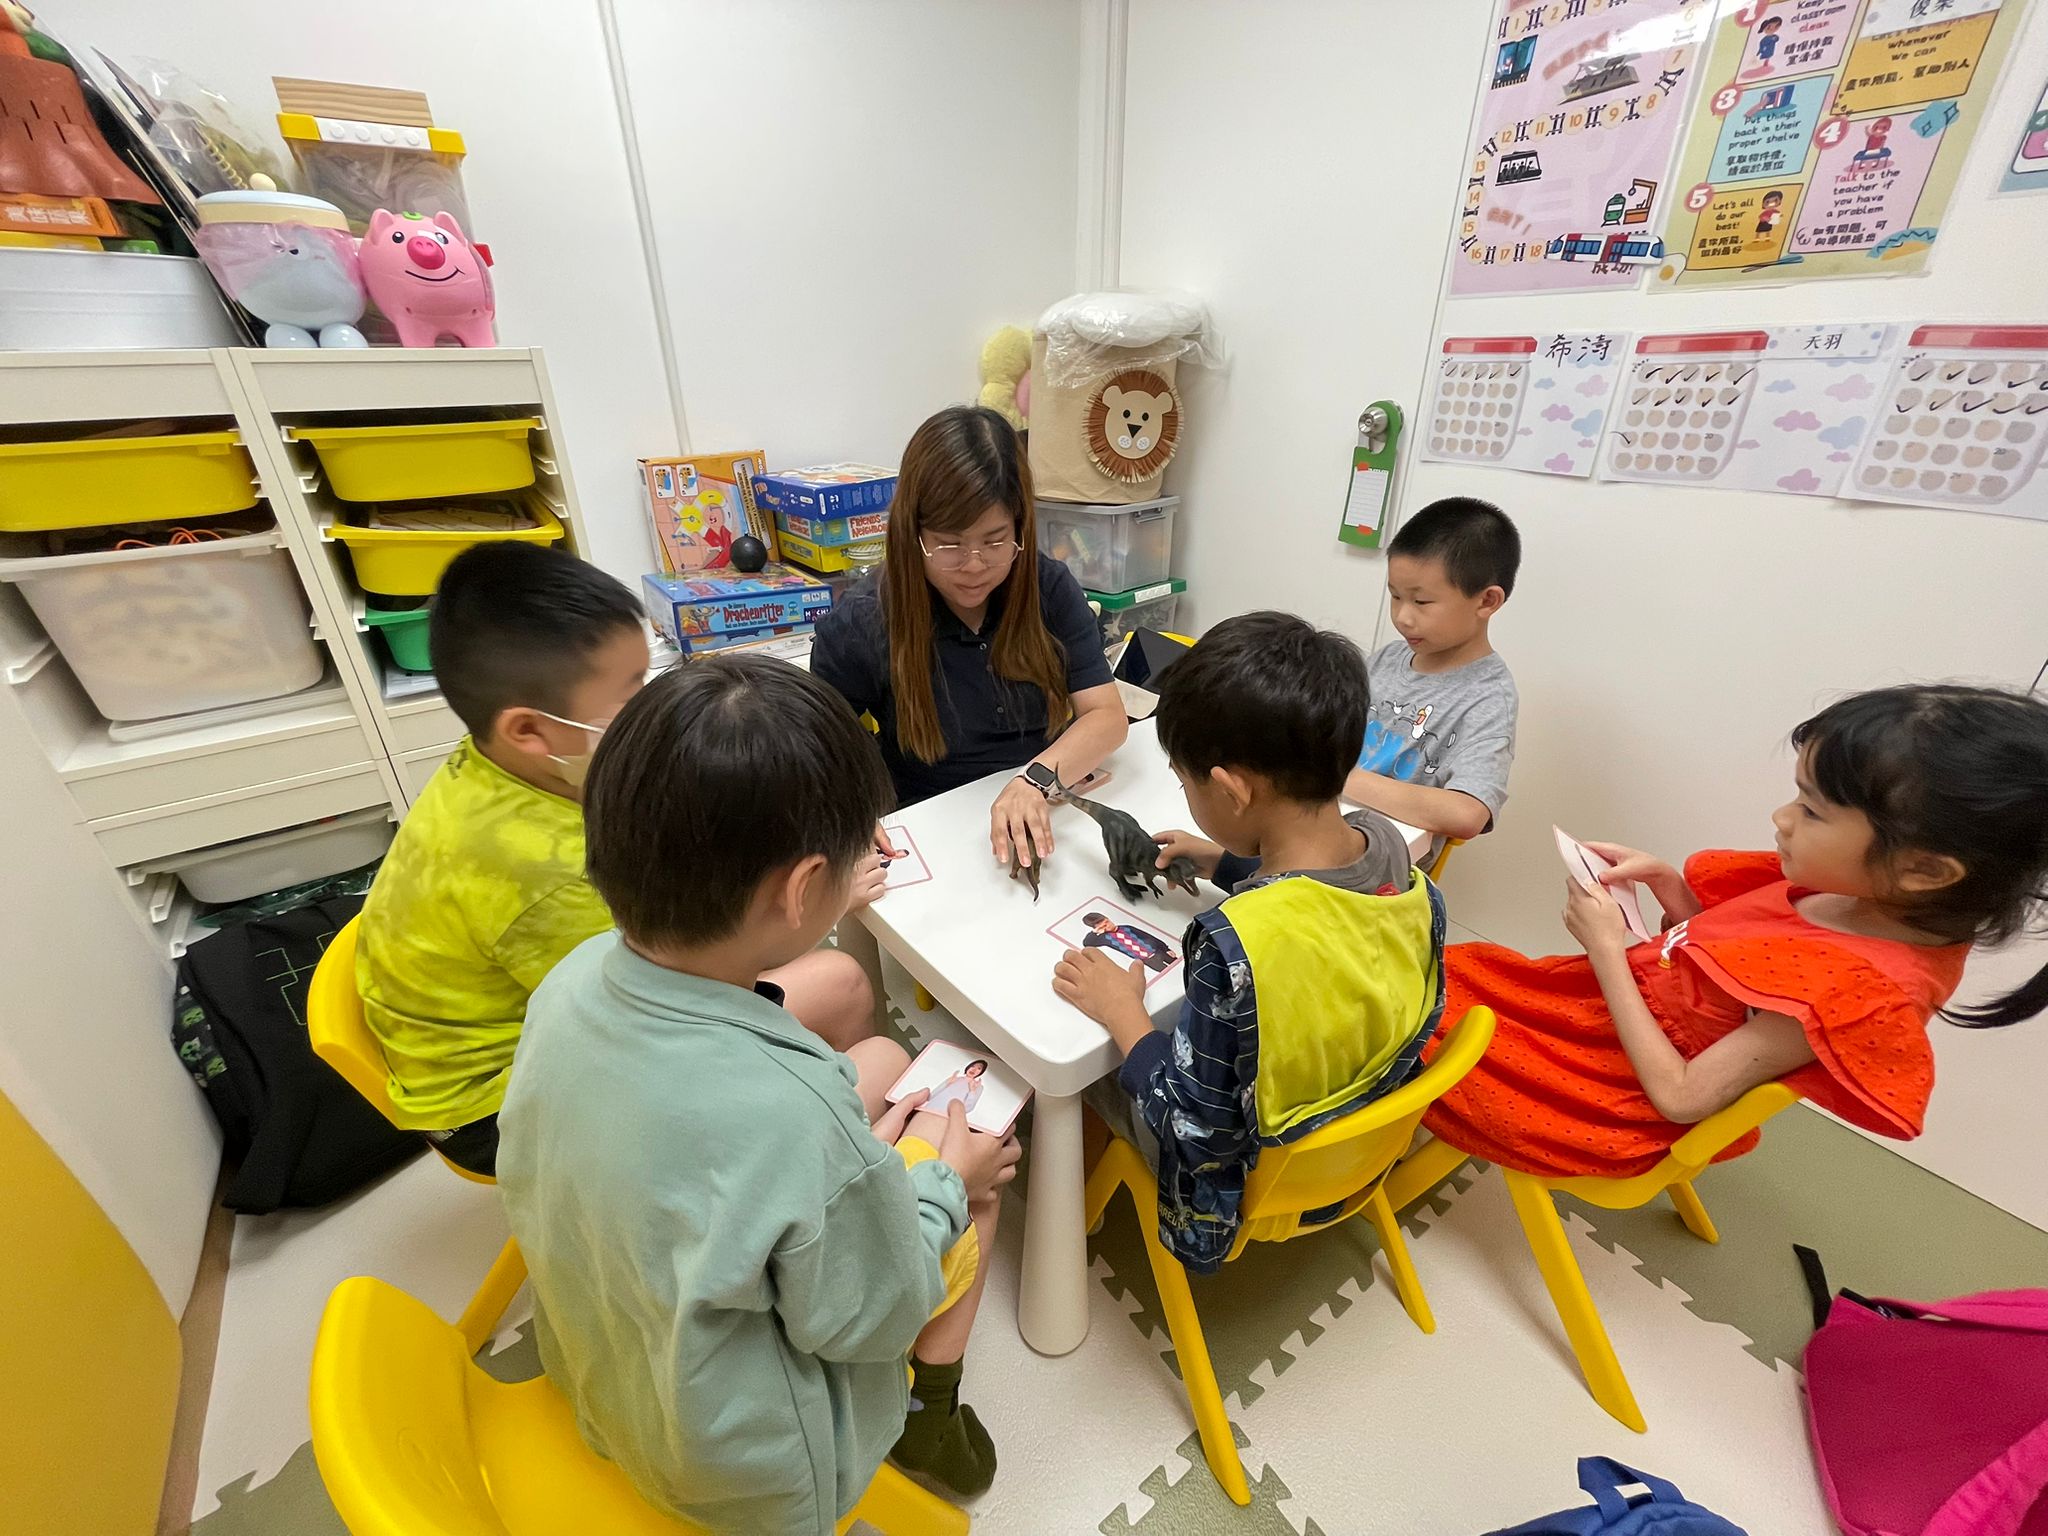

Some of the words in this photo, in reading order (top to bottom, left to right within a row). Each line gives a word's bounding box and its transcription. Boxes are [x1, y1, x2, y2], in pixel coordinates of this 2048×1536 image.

[1549, 8, 1559, 20] 2
[1790, 4, 1846, 24] classroom
[1799, 21, 1830, 33] clean
[1887, 30, 1951, 49] whenever
[1673, 49, 1683, 63] 7
[1914, 47, 1937, 58] can
[1646, 94, 1657, 109] 8
[1716, 88, 1738, 110] 3
[1569, 114, 1583, 128] 10
[1609, 107, 1620, 121] 9
[1766, 110, 1797, 123] things
[1536, 122, 1545, 134] 11
[1734, 127, 1758, 138] back
[1775, 120, 1802, 132] their
[1819, 121, 1842, 144] 4
[1502, 131, 1512, 142] 12
[1728, 138, 1762, 151] proper
[1766, 133, 1801, 144] shelve
[1475, 160, 1486, 173] 13
[1835, 175, 1858, 184] Talk
[1863, 172, 1876, 181] to
[1880, 169, 1901, 180] the
[1833, 183, 1878, 195] teacher
[1882, 179, 1895, 190] if
[1469, 192, 1480, 204] 14
[1689, 188, 1710, 209] 5
[1712, 201, 1737, 210] Let's
[1740, 198, 1754, 207] all
[1834, 198, 1853, 208] you
[1856, 194, 1885, 203] have
[1715, 211, 1727, 221] do
[1729, 210, 1747, 219] our
[1837, 205, 1884, 218] problem
[1464, 221, 1475, 233] 15
[1471, 248, 1481, 259] 16
[1500, 248, 1511, 259] 17
[1530, 244, 1542, 256] 18
[1802, 333, 1843, 350] 天羽
[850, 513, 882, 529] FRIENDS
[723, 603, 785, 624] Drachenritter
